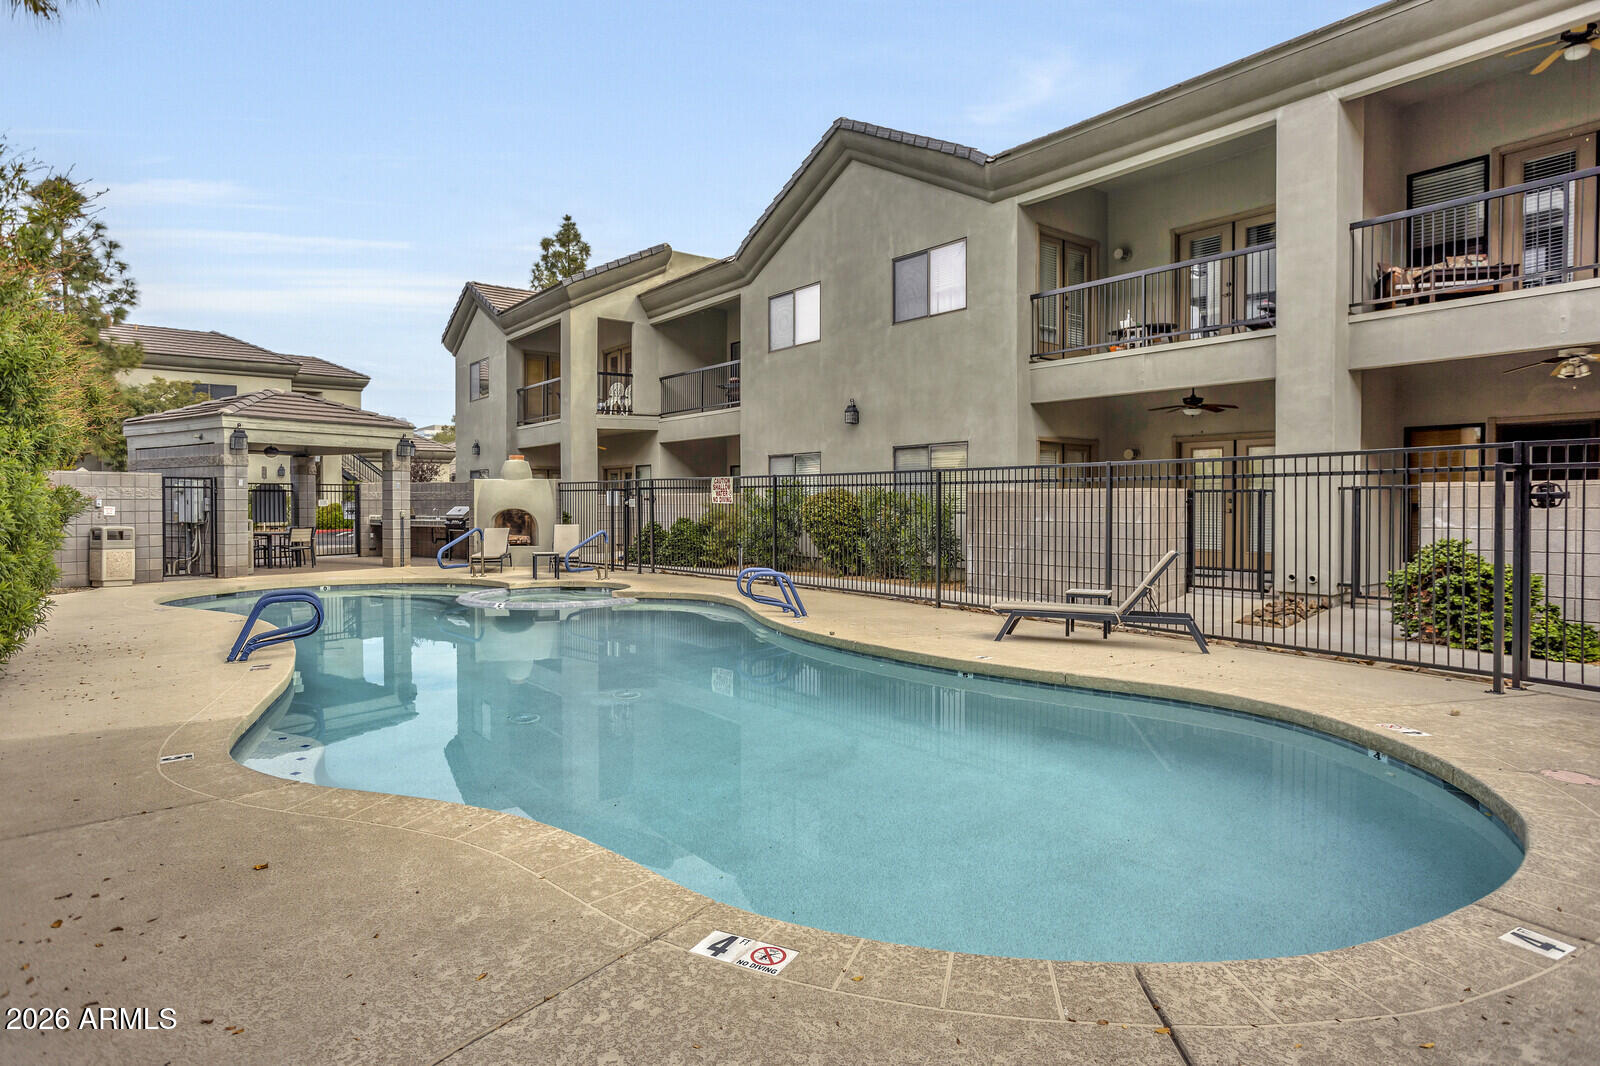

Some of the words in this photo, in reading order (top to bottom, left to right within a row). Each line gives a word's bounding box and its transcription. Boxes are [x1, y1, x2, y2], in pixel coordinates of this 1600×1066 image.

[706, 935, 739, 957] 4
[739, 938, 751, 946] FT
[736, 959, 749, 967] NO
[749, 963, 778, 975] DIVING
